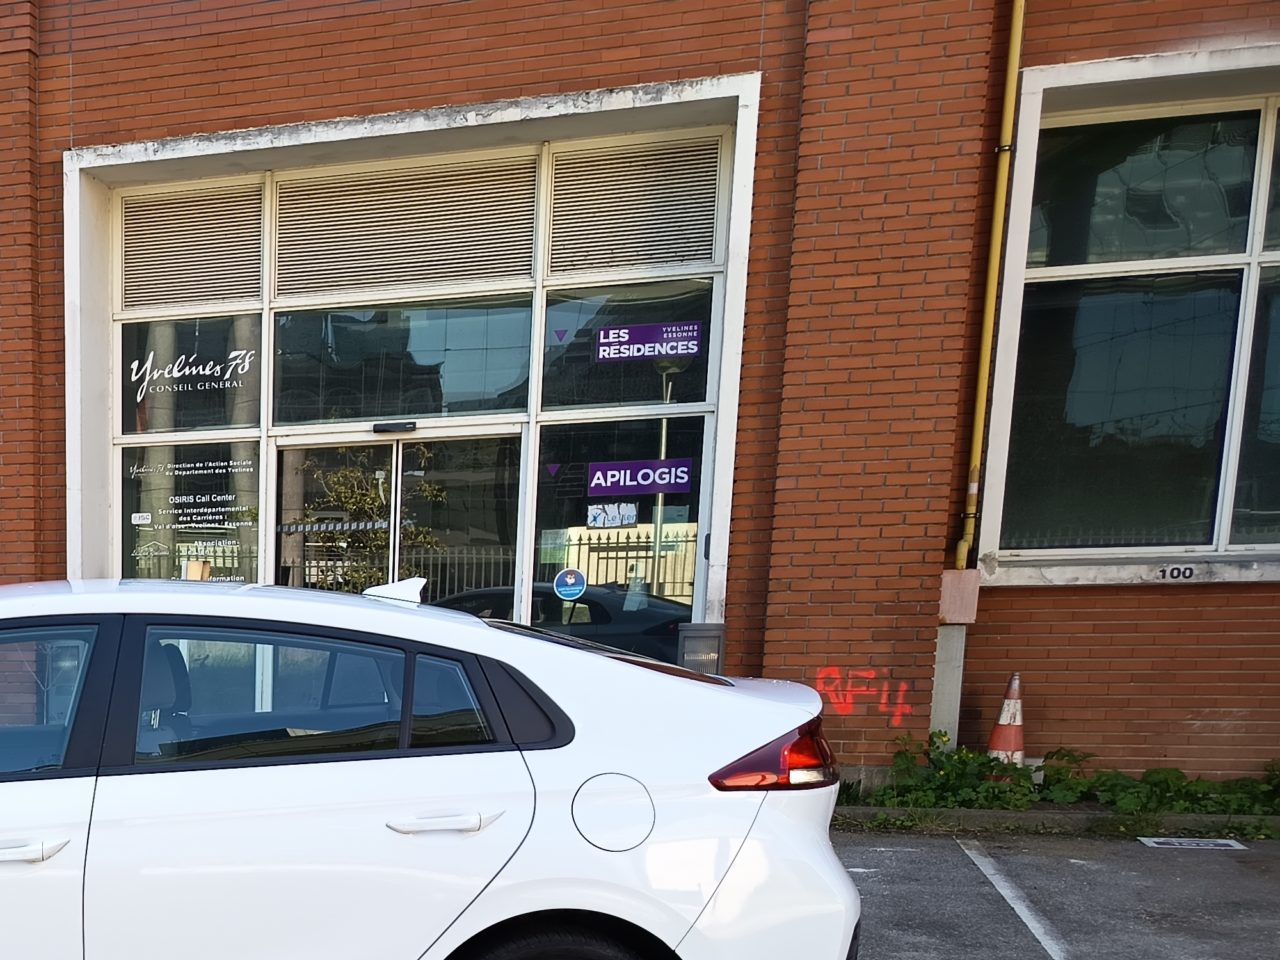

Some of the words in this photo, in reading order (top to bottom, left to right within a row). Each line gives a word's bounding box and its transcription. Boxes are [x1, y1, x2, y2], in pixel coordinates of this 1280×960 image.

[599, 329, 629, 343] LES
[130, 351, 225, 403] Yvelines
[223, 350, 256, 380] 78
[149, 383, 193, 394] CONSEIL
[197, 380, 244, 390] GENERAL
[590, 467, 689, 488] APILOGIS
[168, 495, 194, 504] OSIRIS
[195, 494, 210, 503] Call
[211, 494, 236, 502] Center
[158, 507, 182, 515] Service
[183, 505, 249, 515] Interdépartemental
[1159, 567, 1194, 579] 100
